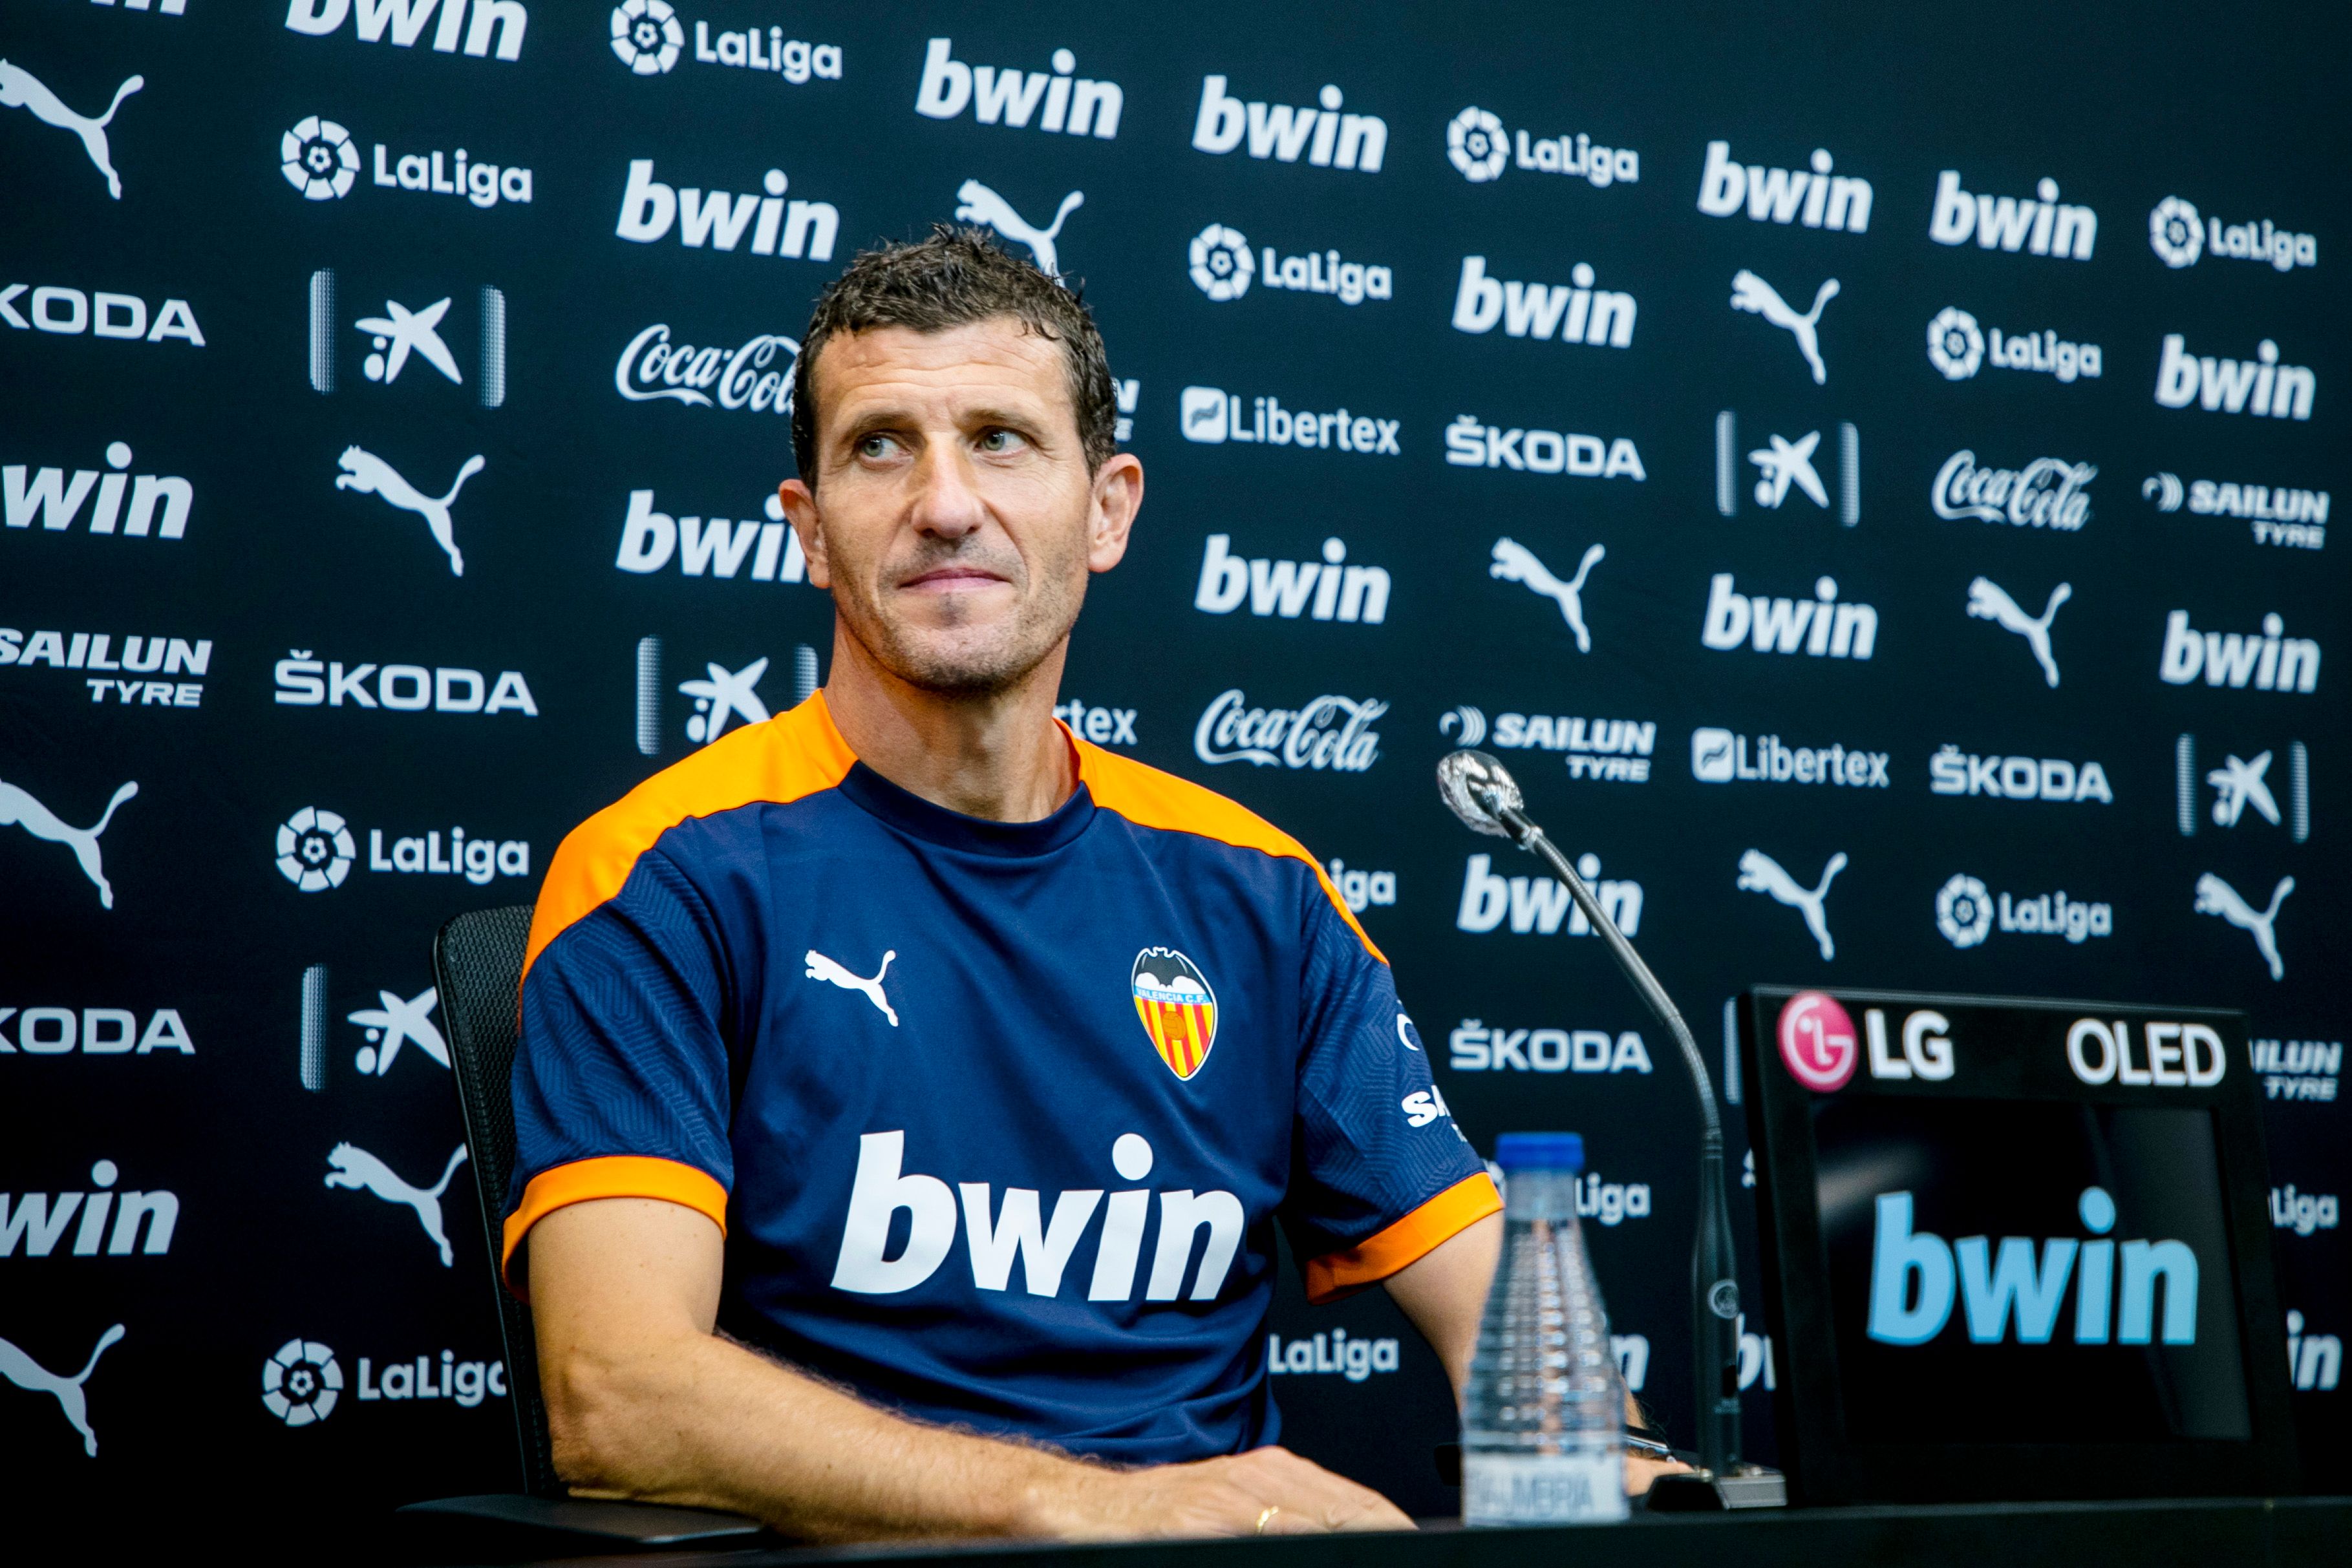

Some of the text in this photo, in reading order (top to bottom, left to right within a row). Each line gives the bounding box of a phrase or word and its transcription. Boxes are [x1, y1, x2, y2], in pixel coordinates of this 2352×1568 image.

[695, 20, 842, 84] LaLiga
[915, 37, 1124, 139] bwin
[1192, 74, 1388, 173] bwin
[374, 143, 533, 207] LaLiga
[1515, 129, 1639, 188] LaLiga
[1697, 140, 1873, 233] bwin
[615, 159, 840, 262] bwin
[1929, 170, 2098, 260] bwin
[2208, 217, 2317, 271] LaLiga
[1262, 247, 1393, 305] LaLiga
[1452, 255, 1638, 348] bwin
[0, 283, 206, 346] KODA
[615, 324, 802, 415] Coca-Col
[1989, 328, 2102, 383] LaLiga
[2155, 334, 2316, 420] bwin
[1229, 395, 1400, 455] Libertex
[1446, 414, 1647, 481] ŠKODA
[2, 441, 193, 539] win
[1930, 449, 2097, 531] Coca-Cola
[2188, 480, 2329, 524] SAILUN
[2252, 520, 2327, 549] TYRE
[1194, 534, 1391, 624] bwin
[1702, 573, 1878, 659] bwin
[275, 649, 539, 716] ŠKODA
[2160, 609, 2321, 693] bwin
[86, 678, 204, 707] TYRE
[1054, 699, 1138, 745] rtex
[1194, 688, 1389, 771] Coca-Cola
[1493, 713, 1656, 754] SAILUN
[1736, 734, 1890, 788] Libertex
[1565, 754, 1651, 783] TYRE
[1929, 744, 2113, 803] ŠKODA
[370, 826, 529, 885] LaLiga
[1330, 858, 1396, 913] iga
[1999, 891, 2112, 944] LaLiga
[1135, 988, 1207, 1003] VALENCIA C.F.
[1450, 1019, 1652, 1073] ŠKODA
[1865, 1008, 1955, 1081] LG
[2066, 1018, 2227, 1087] OLED
[2249, 1039, 2342, 1075] ILUN
[2264, 1075, 2338, 1101] TYRE
[0, 1160, 179, 1256] win
[830, 1129, 1245, 1302] bwin
[1576, 1172, 1651, 1225] Liga
[2271, 1184, 2338, 1235] Liga
[1867, 1186, 2199, 1346] bwin
[1268, 1328, 1399, 1381] LaLiga
